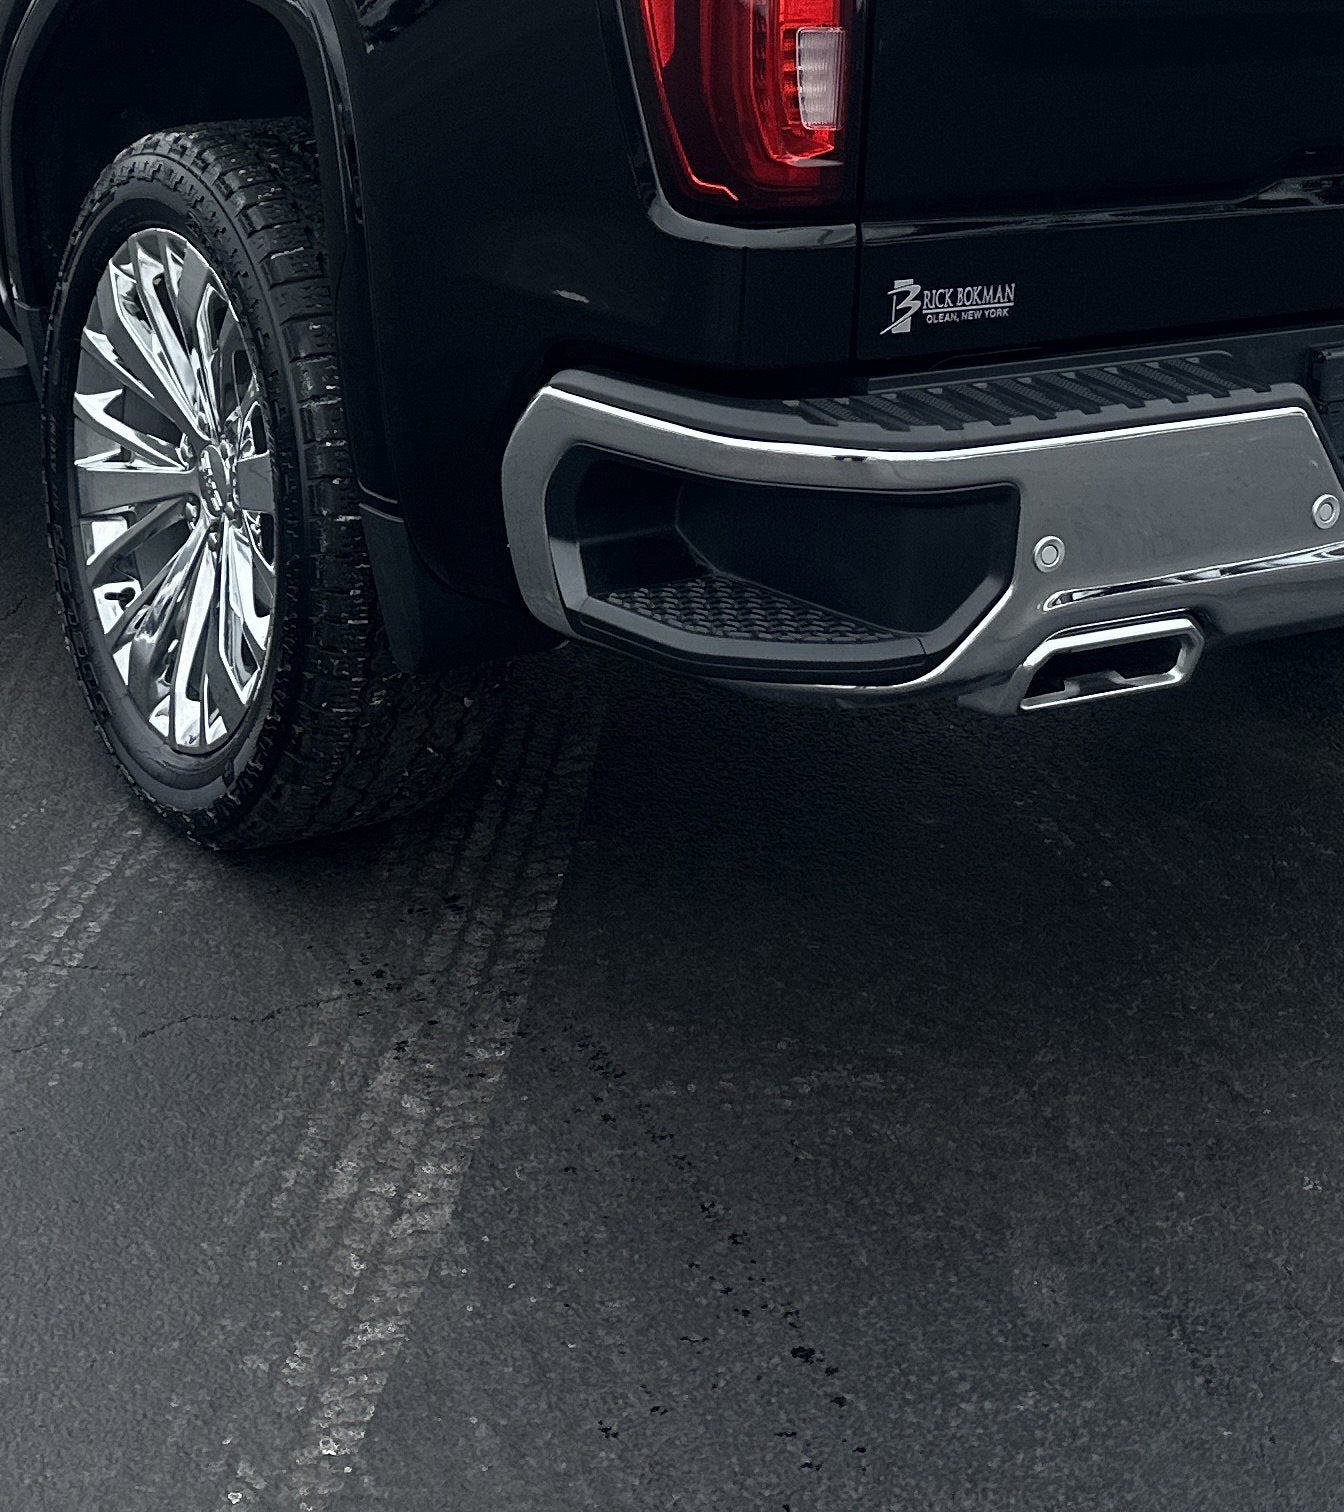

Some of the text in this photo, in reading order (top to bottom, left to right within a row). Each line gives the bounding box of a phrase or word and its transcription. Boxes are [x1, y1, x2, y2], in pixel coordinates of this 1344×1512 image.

[956, 282, 1016, 306] BOKMAN
[926, 307, 1010, 324] OLEAN, NEW YORK
